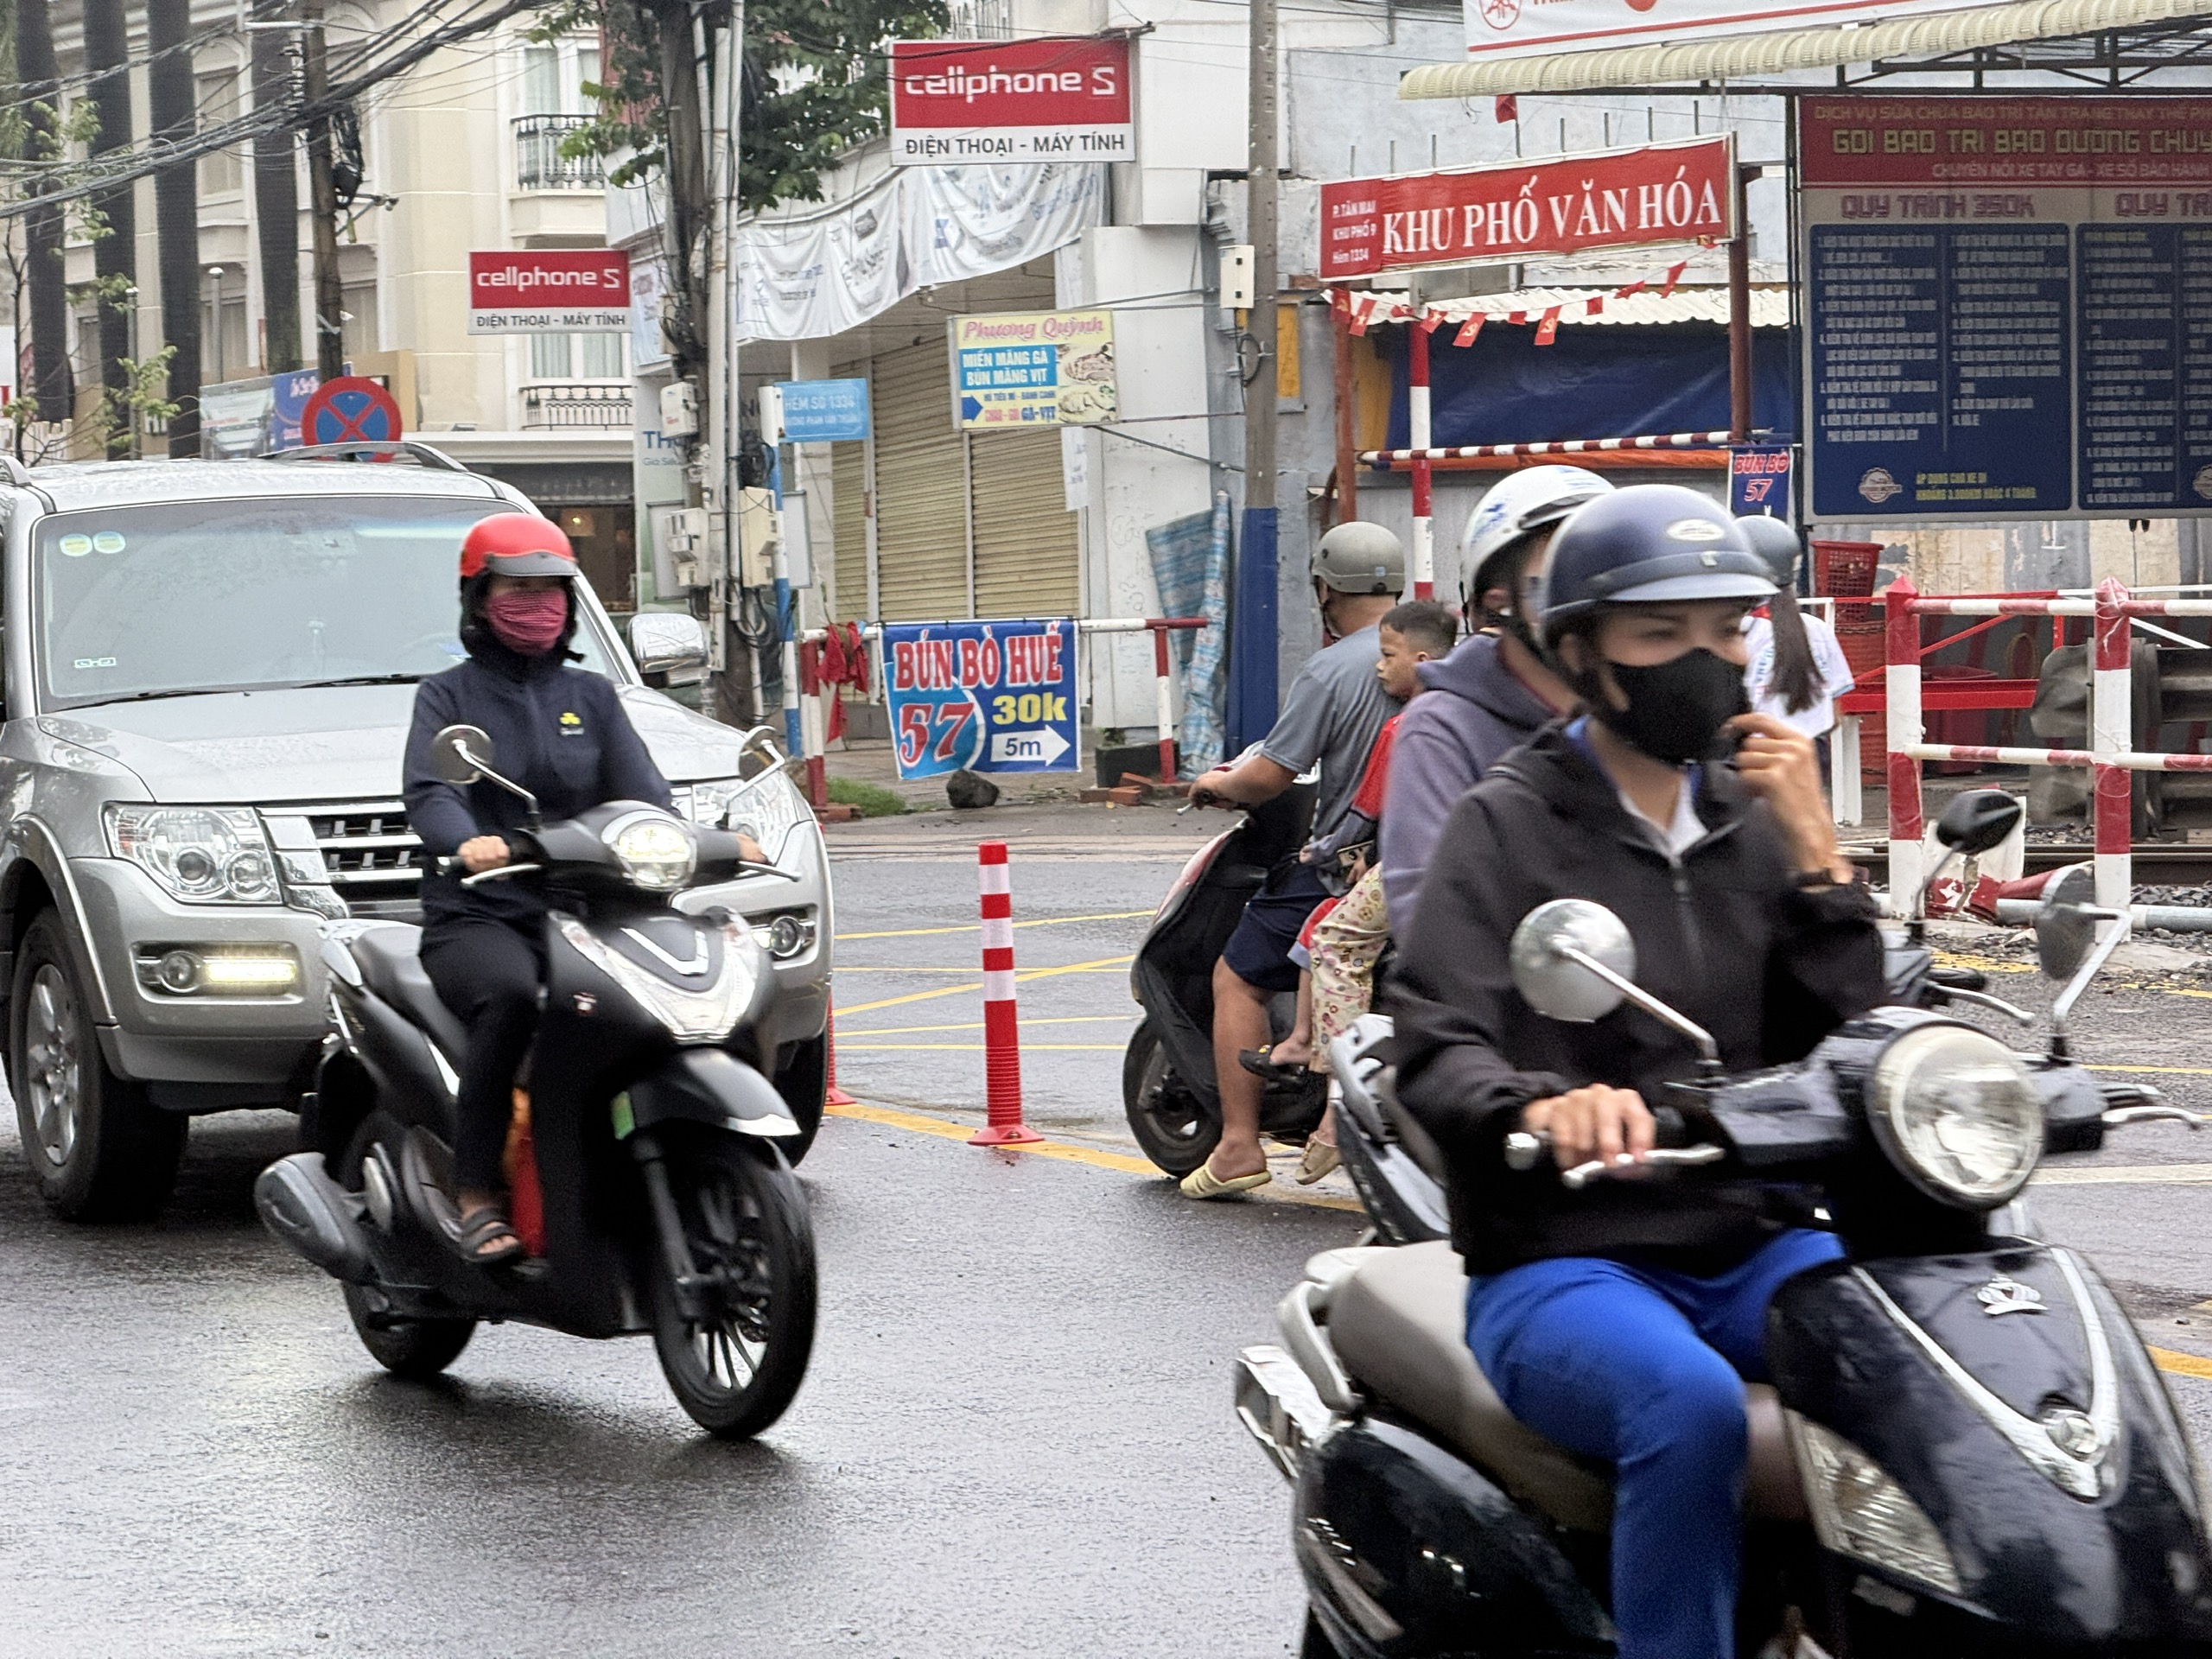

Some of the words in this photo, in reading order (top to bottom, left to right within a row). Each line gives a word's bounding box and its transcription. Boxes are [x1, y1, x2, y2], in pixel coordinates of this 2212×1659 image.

[906, 65, 1082, 103] cellphone
[906, 135, 950, 157] ĐIỆN
[956, 138, 1013, 156] THOẠI
[1033, 133, 1074, 152] MÁY
[1080, 131, 1124, 151] TÍNH
[1382, 207, 1455, 254] KHU
[1462, 175, 1539, 248] PHỐ
[1548, 178, 1629, 239] VĂN
[1637, 165, 1722, 230] HÓA
[477, 266, 598, 291] cellphone
[477, 314, 506, 328] ĐIỆN
[511, 315, 550, 327] THOẠI
[563, 312, 590, 325] MÁY
[594, 311, 625, 325] TÍNH
[1733, 449, 1767, 474] BÚN
[1765, 448, 1789, 474] BÒ
[1745, 479, 1773, 501] 57
[893, 628, 953, 691] BÚN
[958, 625, 1001, 689] BÒ
[1006, 620, 1063, 687] HUẾ
[992, 692, 1067, 725] 30k
[899, 702, 975, 768] 57
[1005, 737, 1041, 757] 5m
